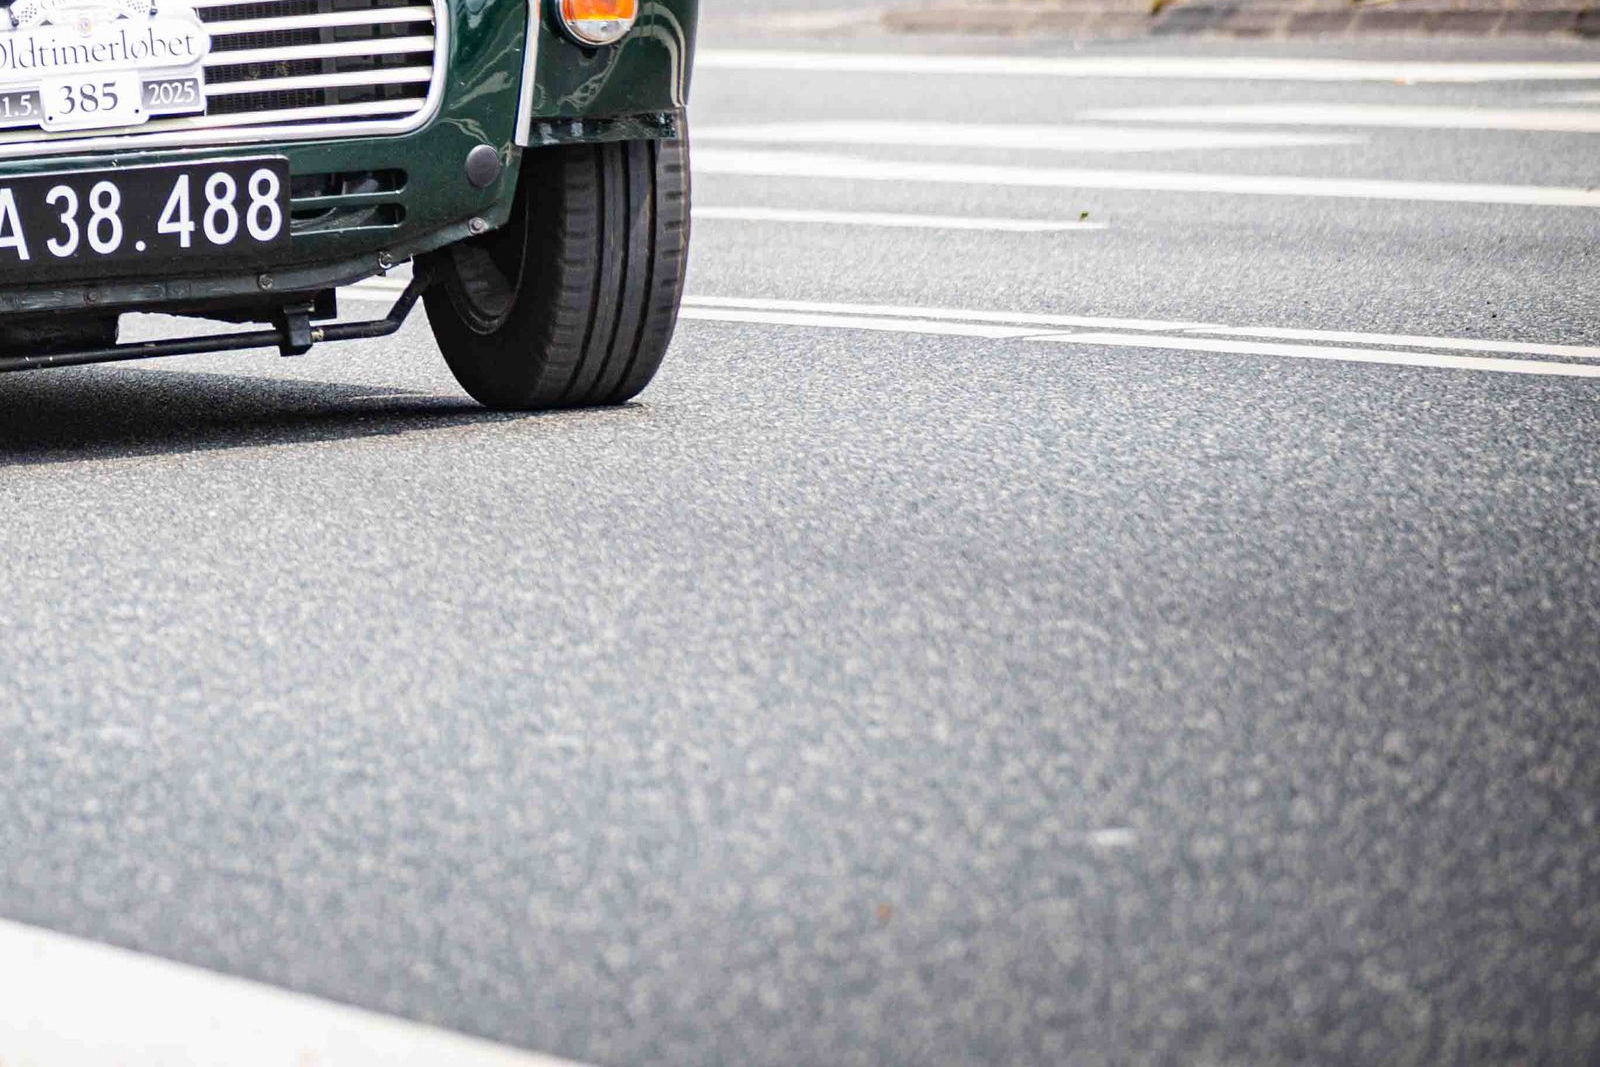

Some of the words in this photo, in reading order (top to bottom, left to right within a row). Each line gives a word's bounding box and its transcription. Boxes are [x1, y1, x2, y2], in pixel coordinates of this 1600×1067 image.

[59, 81, 119, 114] 385
[148, 81, 195, 104] 2025
[45, 168, 282, 257] 38.488
